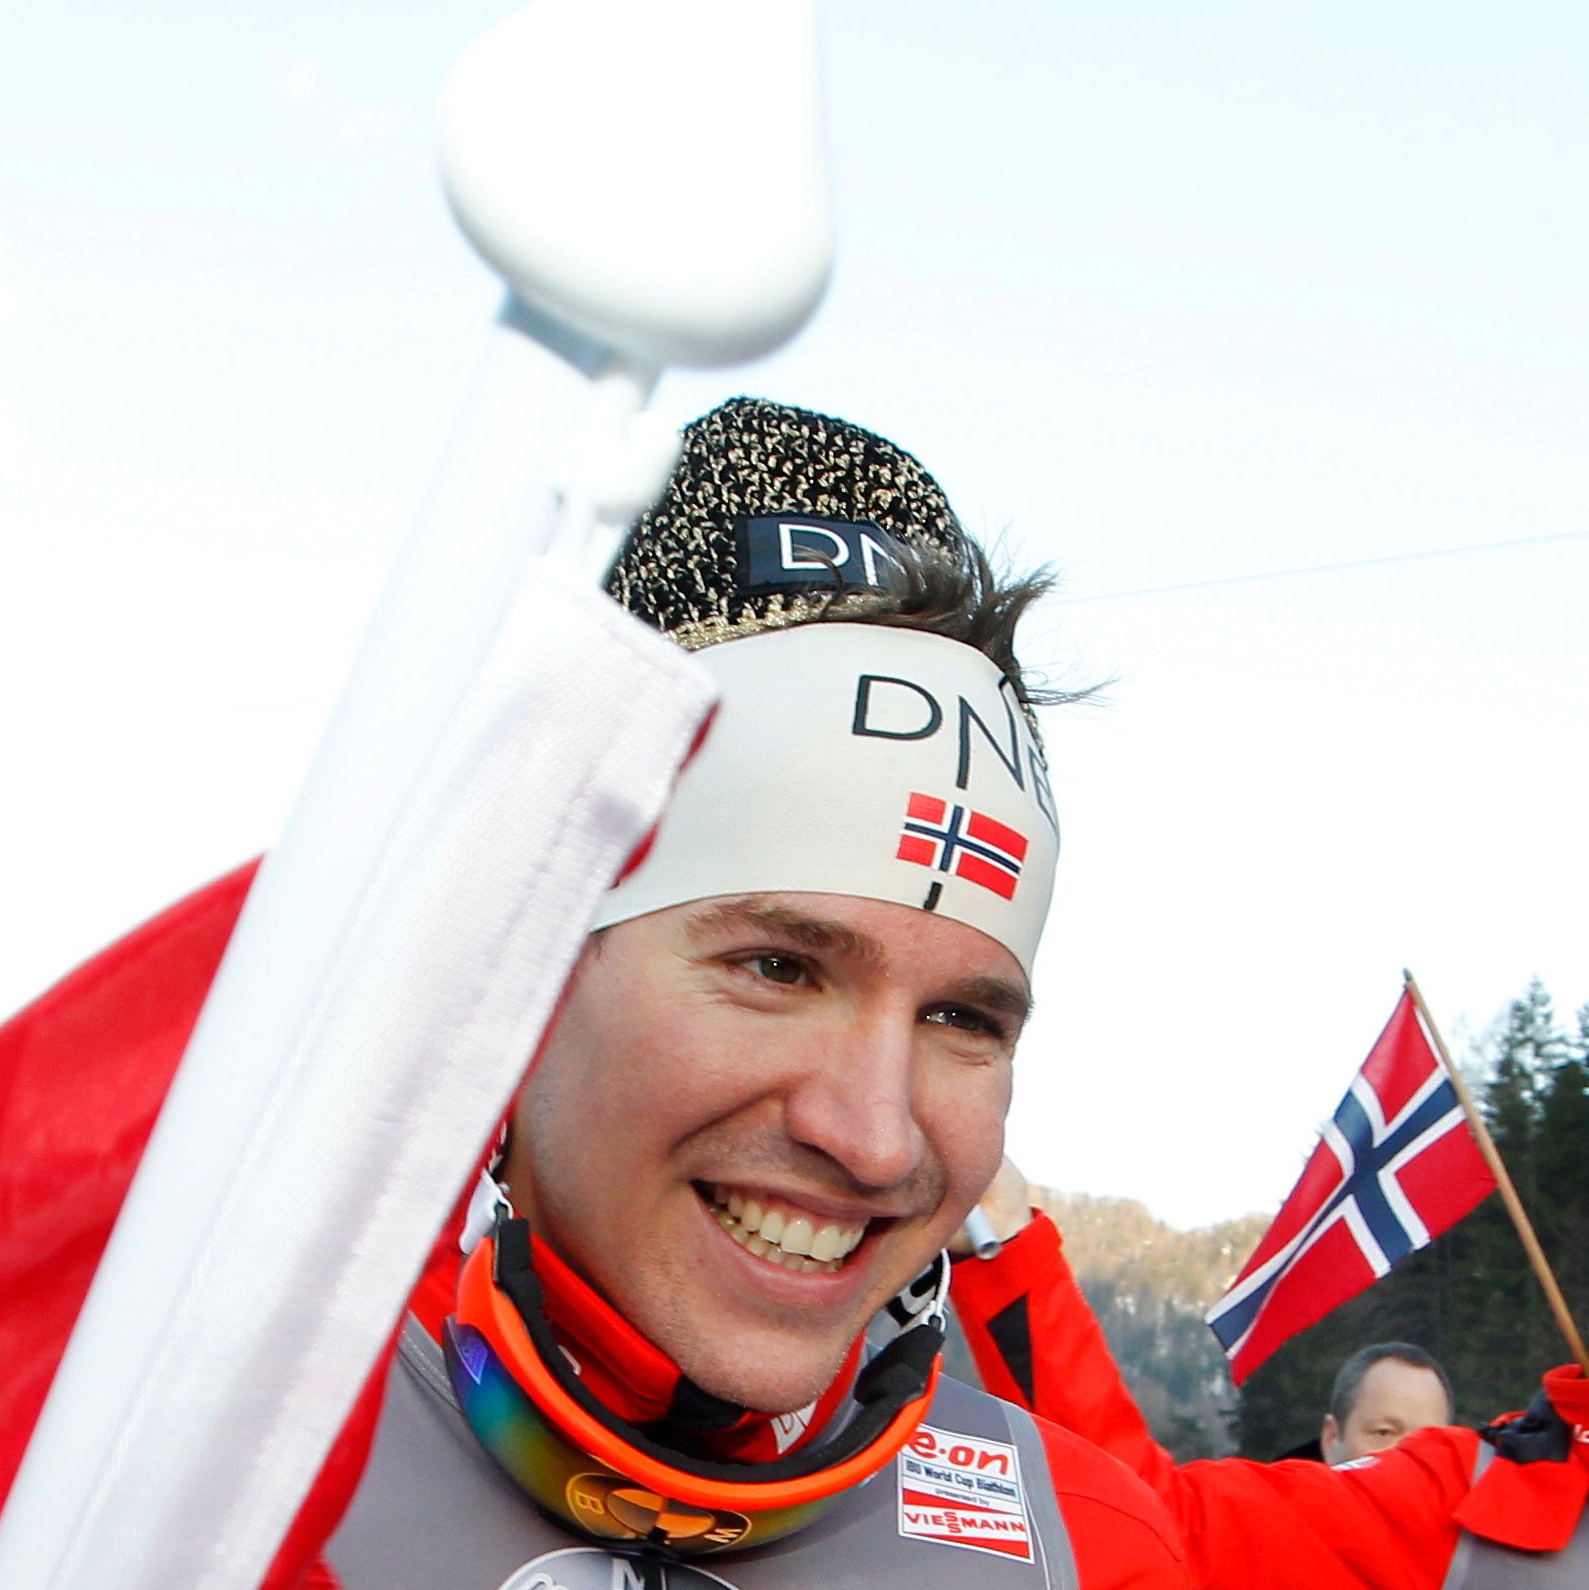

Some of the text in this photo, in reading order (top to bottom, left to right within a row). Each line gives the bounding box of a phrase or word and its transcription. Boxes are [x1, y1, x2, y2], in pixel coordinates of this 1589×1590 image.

[776, 521, 892, 587] DN
[925, 1464, 952, 1482] World
[955, 1472, 974, 1490] Cup
[977, 1478, 1016, 1497] Biathlon
